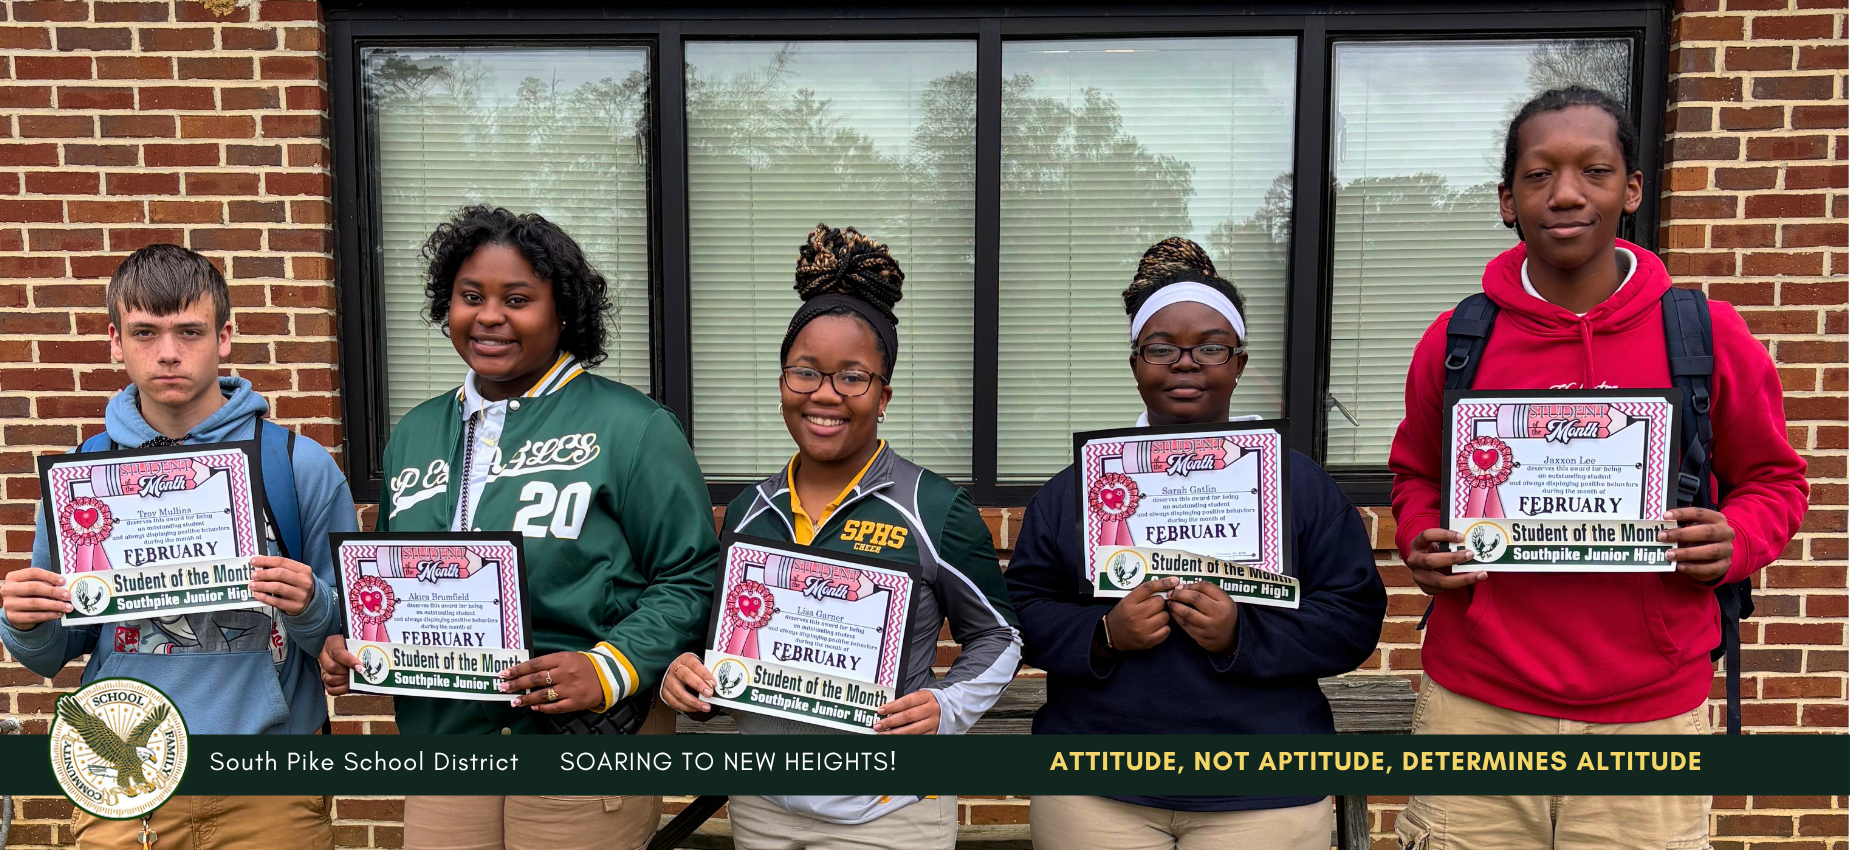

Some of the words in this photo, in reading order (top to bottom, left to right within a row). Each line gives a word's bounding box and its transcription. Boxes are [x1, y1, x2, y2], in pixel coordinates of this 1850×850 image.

[1529, 405, 1607, 418] STUDENT
[1544, 418, 1600, 444] Month
[1152, 439, 1222, 453] STUDENT
[120, 460, 190, 476] STUDENT
[1165, 453, 1215, 477] Month
[1544, 456, 1576, 464] Jaxxon
[1580, 456, 1596, 464] Lee
[138, 474, 186, 498] Month
[1162, 486, 1187, 495] Sarah
[1190, 485, 1217, 493] Gatlin
[159, 507, 191, 516] Mullins
[512, 481, 592, 539] 20
[1519, 496, 1622, 516] FEBRUARY
[841, 520, 908, 549] SPHS
[1146, 523, 1241, 544] FEBRUARY
[1512, 523, 1568, 542] Student
[1573, 524, 1587, 542] of
[1592, 524, 1615, 542] the
[124, 541, 218, 567] FEBRUARY
[403, 548, 465, 559] STUDENT
[854, 543, 881, 553] CHEER
[1513, 547, 1580, 563] Southpike
[1585, 548, 1629, 561] Junior
[1634, 548, 1664, 564] High
[416, 560, 460, 584] Month
[794, 561, 860, 582] STUDENT
[1152, 552, 1202, 572] Student
[1207, 560, 1219, 573] of
[1224, 562, 1244, 577] the
[114, 572, 167, 592] Student
[170, 568, 184, 588] of
[187, 567, 209, 586] the
[802, 576, 850, 601] Month
[1219, 579, 1257, 593] Junior
[1261, 584, 1288, 598] High
[117, 594, 179, 610] Southpike
[184, 590, 224, 604] Junior
[785, 615, 808, 623] deserves
[798, 606, 814, 616] Lisa
[816, 610, 844, 621] Garner
[402, 631, 485, 646] FEBRUARY
[795, 638, 814, 646] during
[799, 632, 827, 642] displaying
[828, 637, 849, 645] positive
[851, 641, 877, 650] behaviors
[802, 626, 833, 636] outstanding
[835, 631, 855, 639] student
[394, 648, 439, 669] Student
[444, 652, 454, 670] of
[459, 653, 477, 671] the
[772, 642, 861, 671] FEBRUARY
[395, 672, 450, 688] Southpike
[453, 676, 489, 690] Junior
[754, 665, 802, 692] Student
[806, 677, 819, 695] of
[822, 680, 842, 699] the
[846, 683, 887, 707] Month
[751, 689, 809, 711] Southpike
[812, 702, 850, 719] Junior
[854, 709, 880, 726] High
